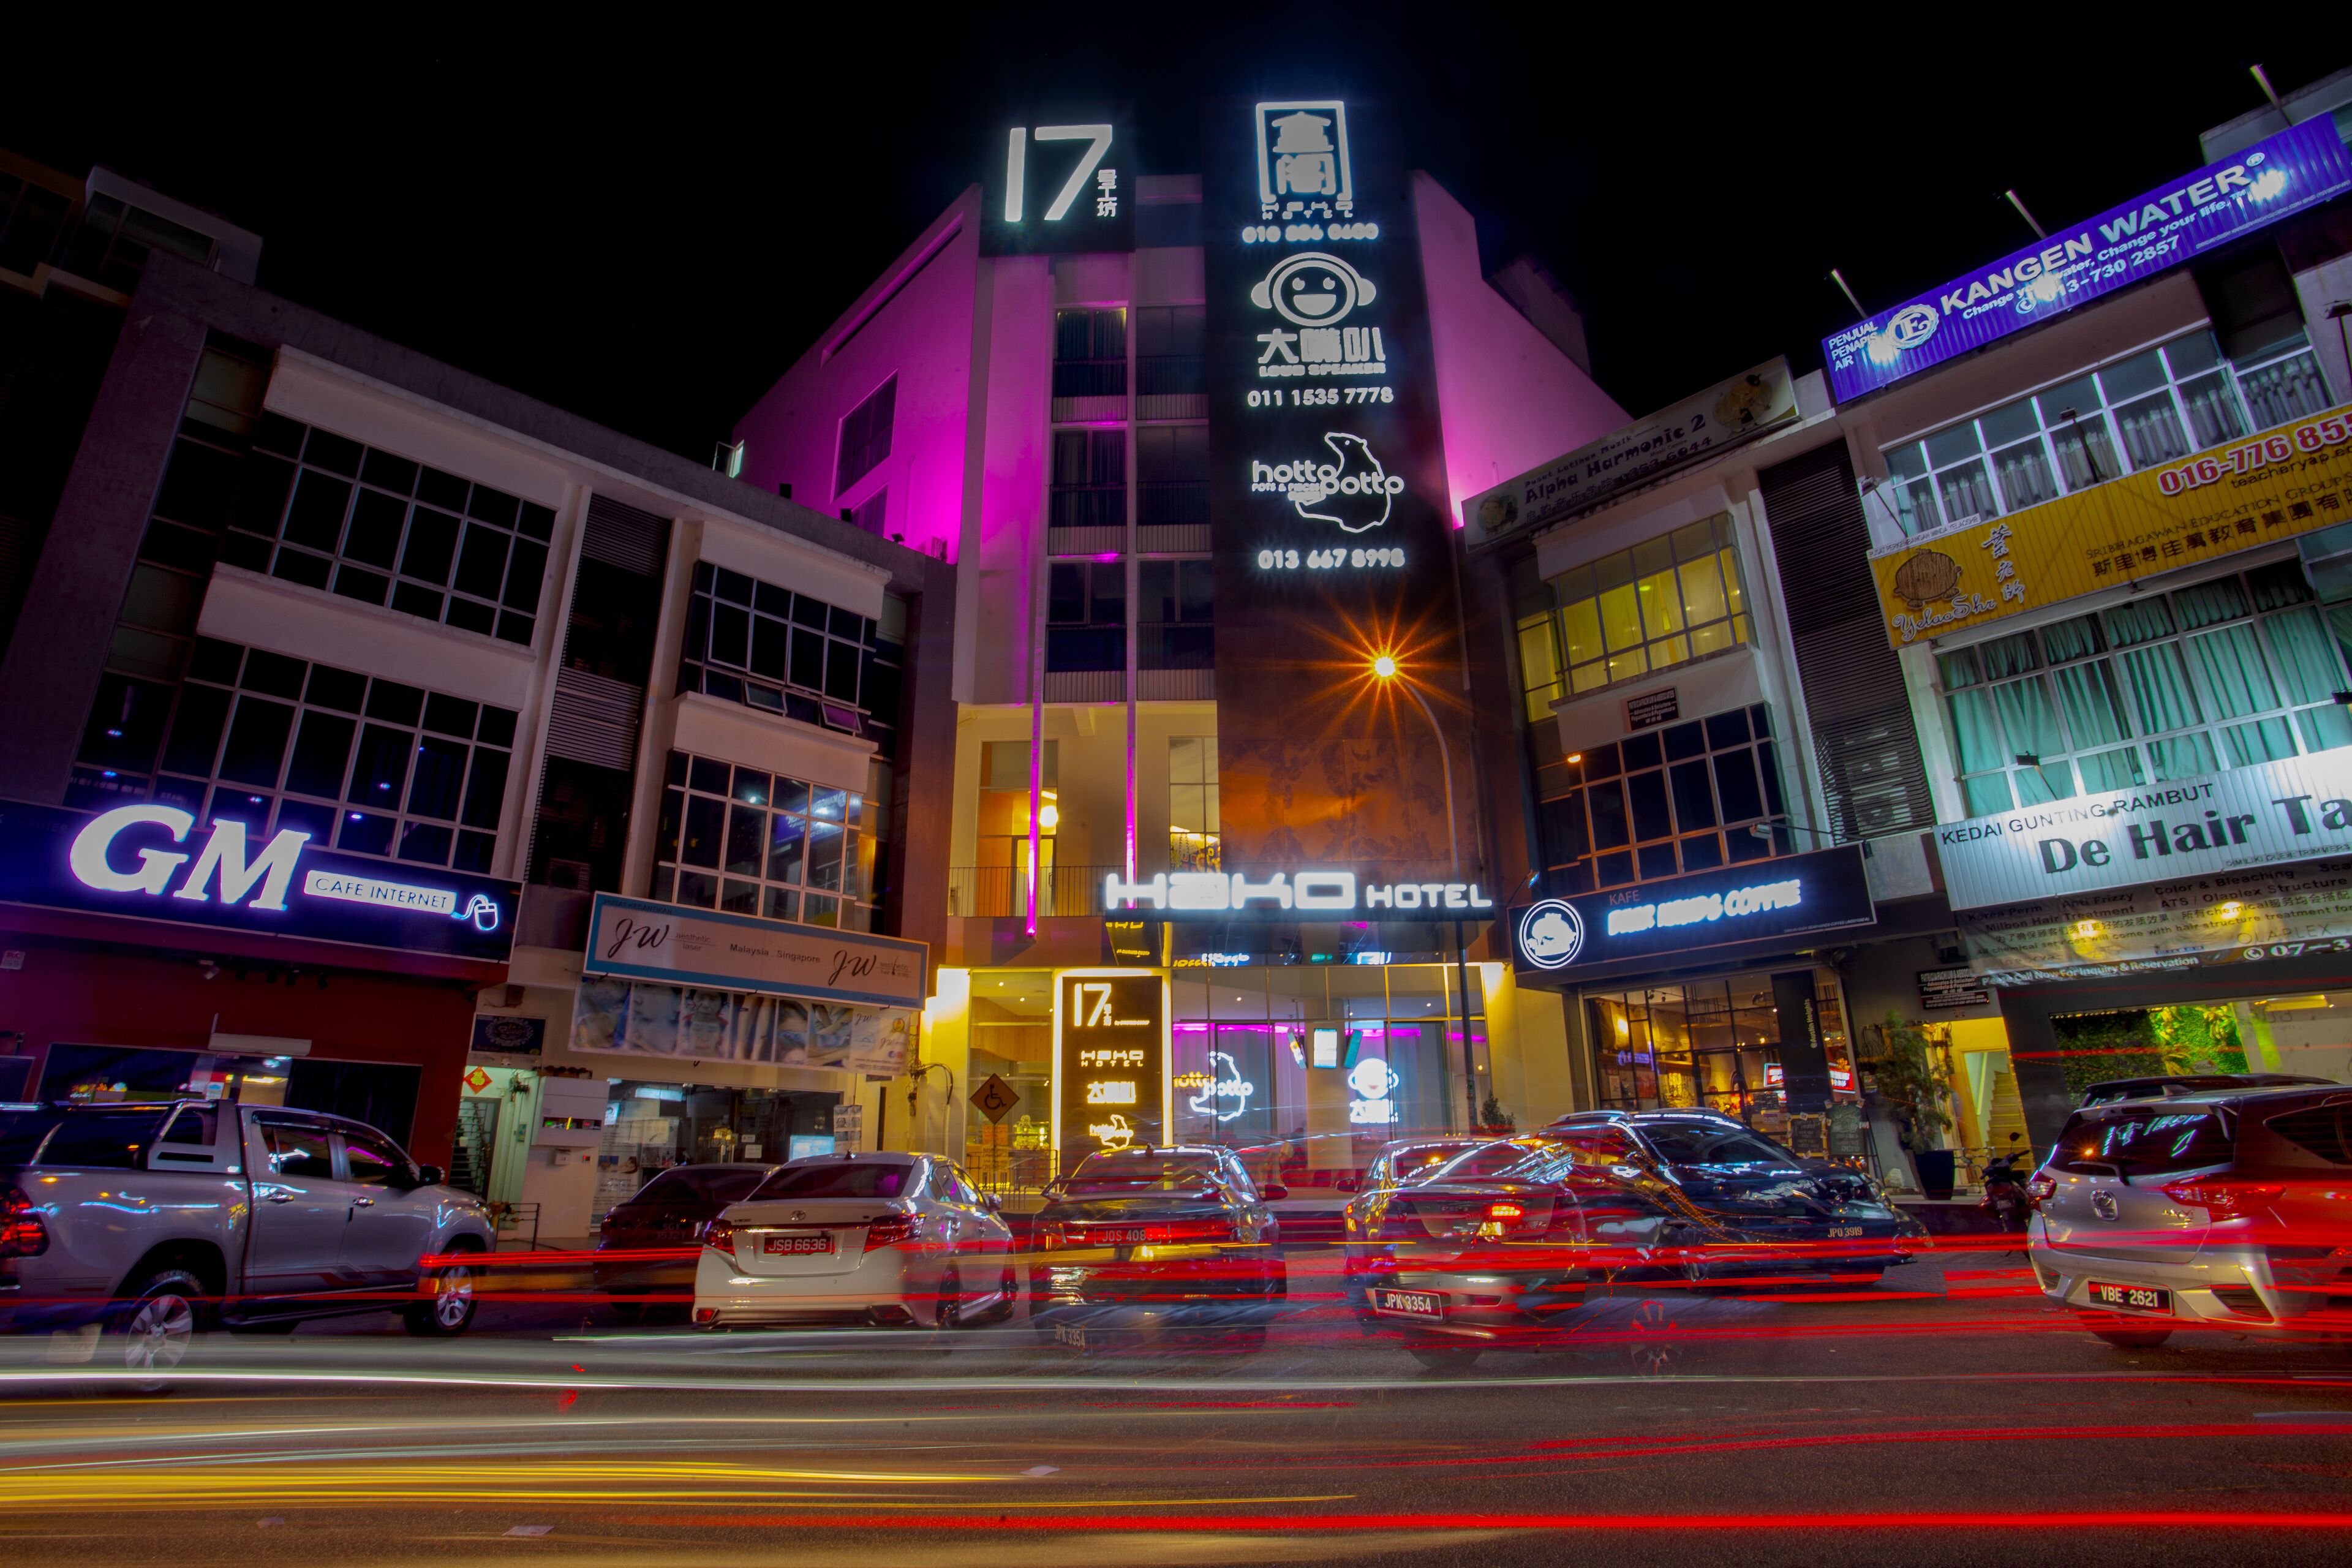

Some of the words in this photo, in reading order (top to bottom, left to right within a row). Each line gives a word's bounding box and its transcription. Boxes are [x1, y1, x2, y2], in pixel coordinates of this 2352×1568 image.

[1005, 124, 1113, 222] 17
[2098, 164, 2253, 244] WATER
[2130, 233, 2180, 265] 2857
[1940, 232, 2095, 315] KANGEN
[1962, 290, 2015, 320] Change
[2097, 230, 2157, 262] Change
[2158, 211, 2198, 237] your
[1828, 320, 1879, 350] PENJUAL
[1834, 355, 1856, 372] AIR
[1247, 390, 1283, 407] 011
[1292, 388, 1339, 405] 1535
[1344, 386, 1394, 404] 7778
[1253, 460, 1337, 483] hotto
[1524, 472, 1579, 505] Alpha
[1586, 426, 1685, 478] Harmonic
[1690, 413, 1706, 433] 2
[2158, 434, 2293, 496] 016-776
[2190, 492, 2281, 529] EDUCATION
[2283, 474, 2343, 500] GROUP
[1258, 549, 1300, 569] 013
[1306, 549, 1348, 568] 667
[1941, 823, 2003, 845] KEDAI
[2009, 804, 2107, 832] GUNTING
[2113, 783, 2213, 813] RAMBUT
[2038, 837, 2111, 874] De
[2126, 810, 2256, 859] Hair
[70, 804, 311, 911] GM
[315, 878, 364, 896] CAFE
[369, 886, 448, 908] INTERNET
[1366, 884, 1493, 908] HOTEL
[1609, 889, 1640, 906] KAFE
[1724, 879, 1801, 916] COFFEE
[1986, 919, 2027, 933] Milbon
[2032, 914, 2059, 925] Hair
[2064, 905, 2136, 921] Treatment
[2161, 897, 2189, 908] ATS
[2203, 888, 2263, 903] Olaplex
[2267, 878, 2348, 893] Structure
[2010, 904, 2043, 915] Perm
[2094, 892, 2133, 905] Frizzy
[2154, 881, 2193, 895] Color
[2215, 869, 2294, 887] Bleaching
[676, 932, 710, 943] aesthetic
[2113, 931, 2144, 940] come
[2147, 926, 2173, 936] with
[2176, 923, 2199, 932] hair
[2265, 907, 2331, 921] treatment
[2237, 924, 2334, 944] OLAPLEX
[682, 942, 702, 952] laser
[729, 944, 769, 958] Malaysia
[776, 949, 821, 964] Singapore
[2119, 963, 2129, 972] &
[2130, 955, 2199, 970] Reservation
[1074, 983, 1112, 1027] 17
[768, 1238, 793, 1252] JSB
[795, 1237, 827, 1251] 6636
[1845, 1226, 1863, 1237] 3919
[1385, 1293, 1403, 1309] JPK
[1405, 1296, 1432, 1313] 3354
[2100, 1286, 2123, 1303] VBE
[2129, 1290, 2158, 1308] 2621
